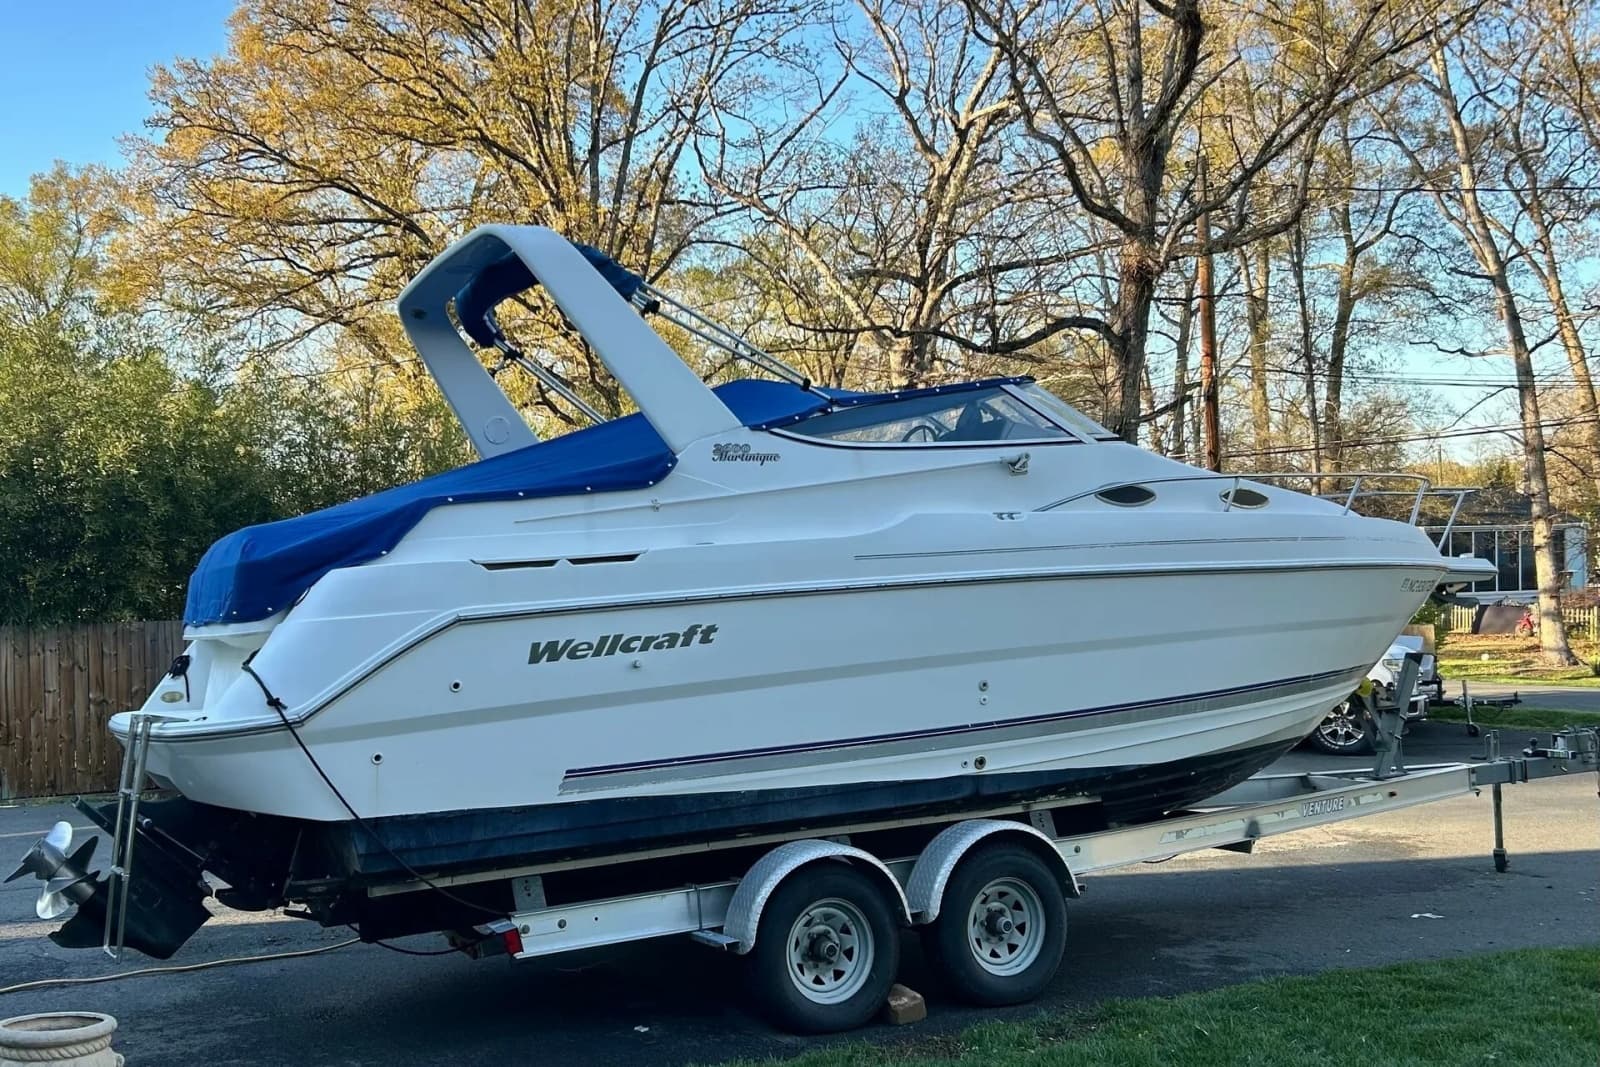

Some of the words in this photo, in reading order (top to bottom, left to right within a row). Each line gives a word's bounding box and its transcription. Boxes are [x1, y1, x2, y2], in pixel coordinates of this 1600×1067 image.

[712, 451, 781, 466] Martinique
[528, 624, 719, 664] Wellcraft
[1303, 796, 1345, 817] VENTURE
